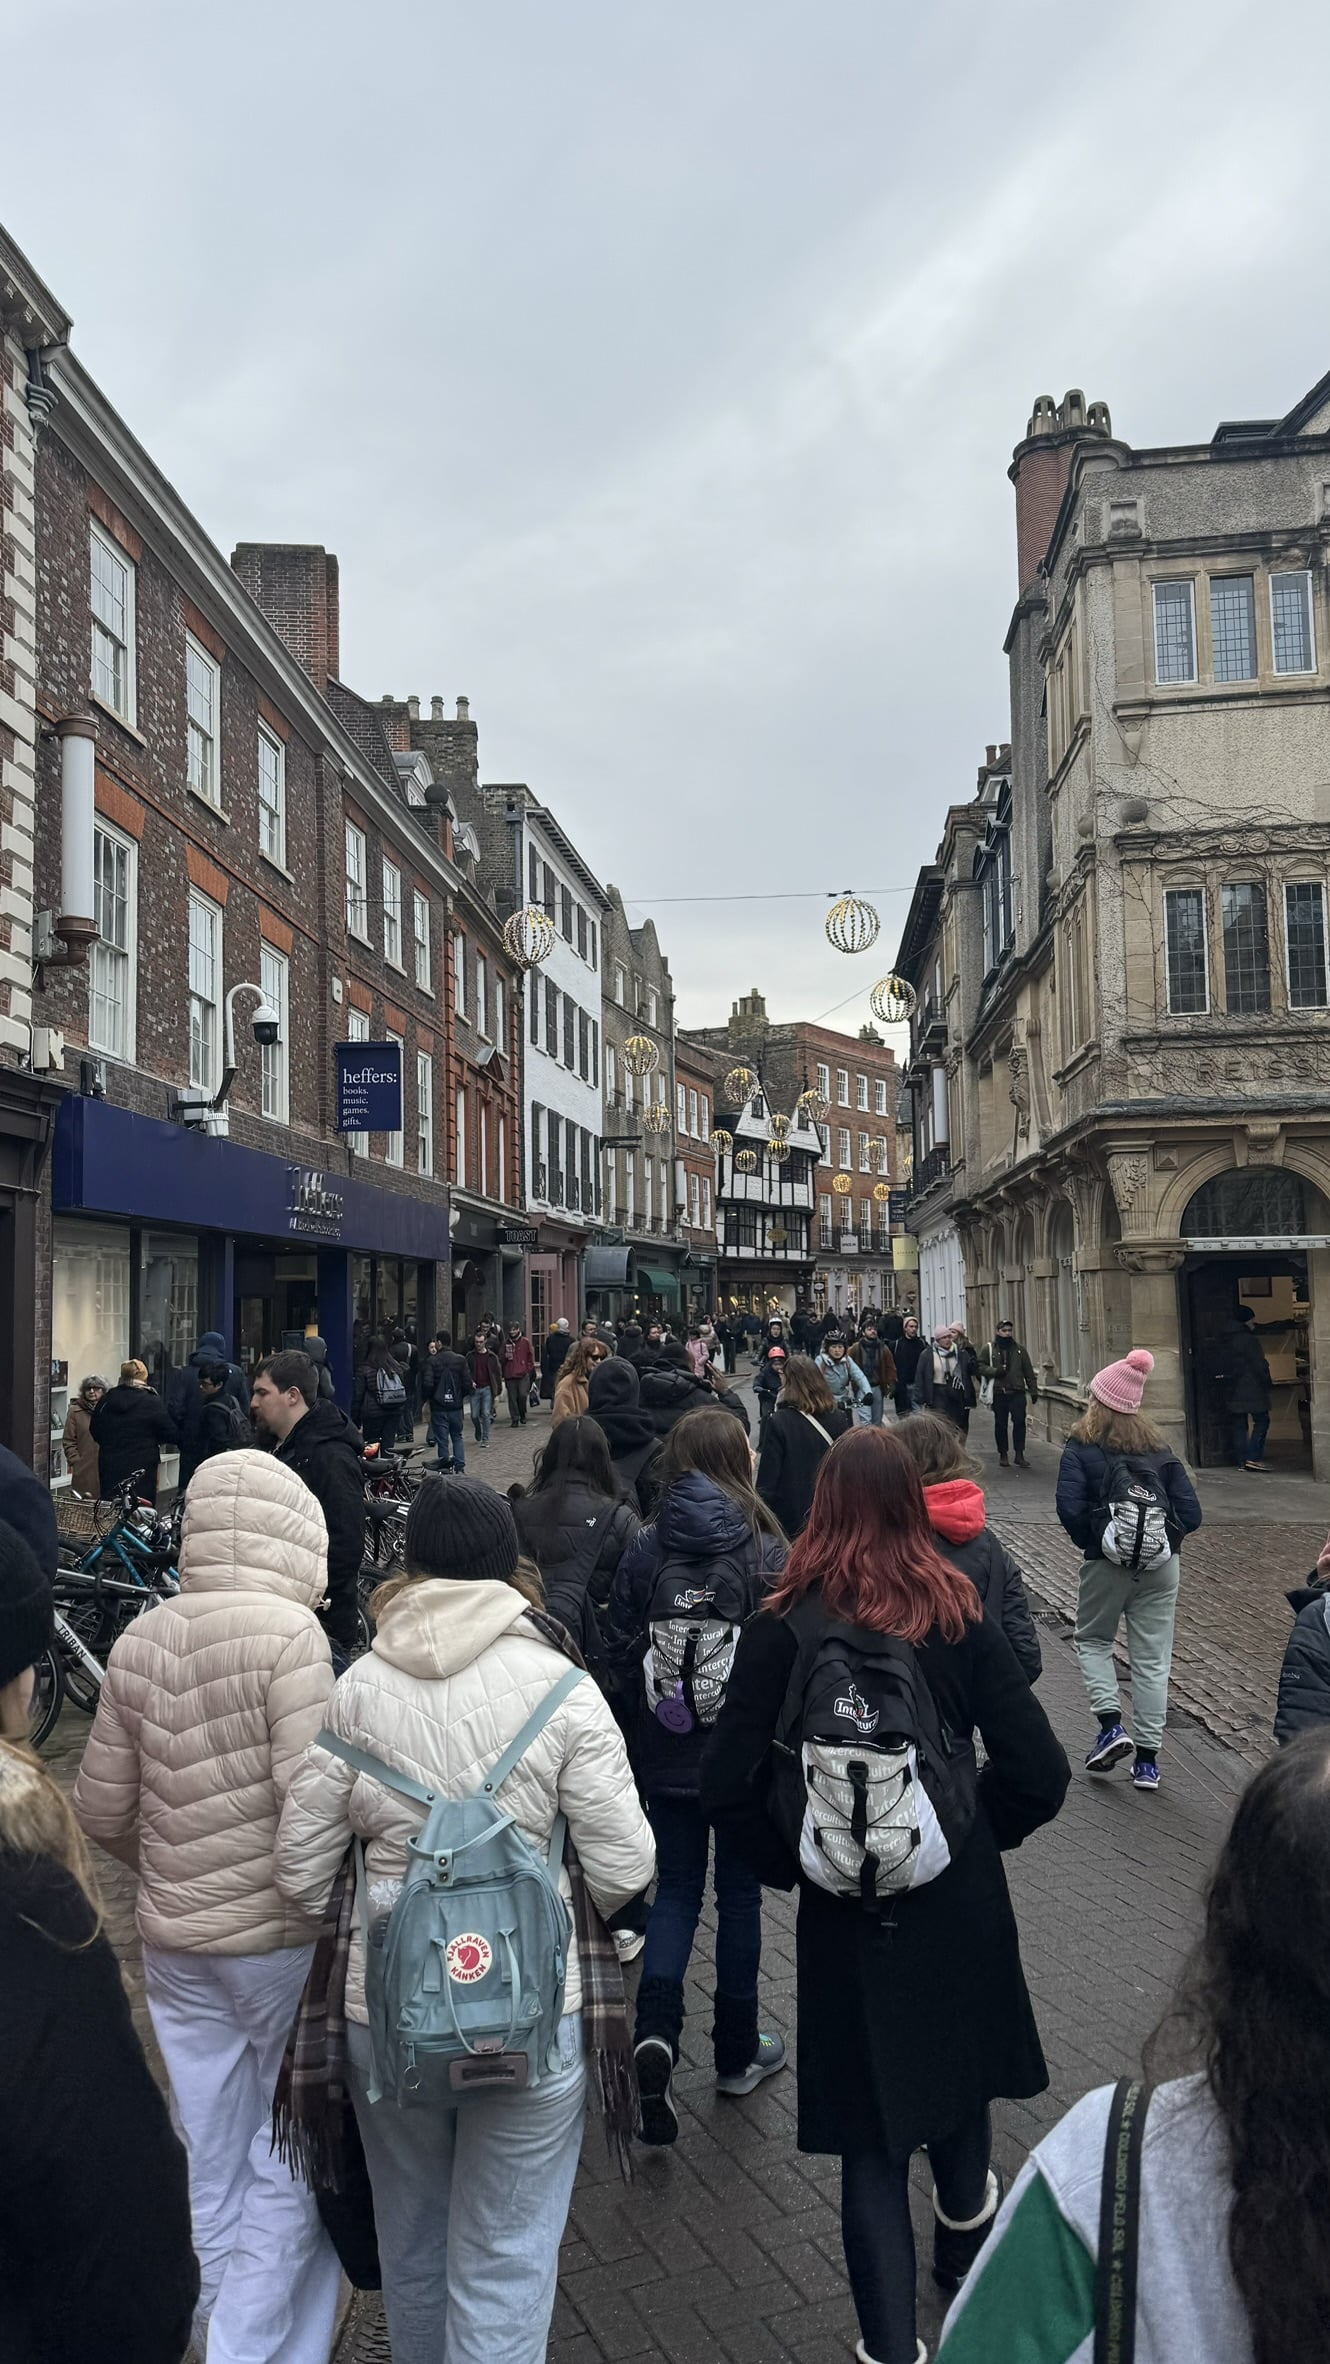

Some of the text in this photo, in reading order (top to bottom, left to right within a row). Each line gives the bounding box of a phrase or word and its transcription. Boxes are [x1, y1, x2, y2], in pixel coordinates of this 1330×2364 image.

[342, 1067, 398, 1084] heffers:
[1197, 1058, 1313, 1082] REISS
[342, 1086, 370, 1095] books.
[342, 1096, 370, 1105] music.
[342, 1107, 371, 1116] games.
[342, 1117, 362, 1127] gifts.
[504, 1229, 537, 1242] TOAST
[58, 1624, 87, 1658] TRIBAN
[1112, 2227, 1126, 2253] SOL
